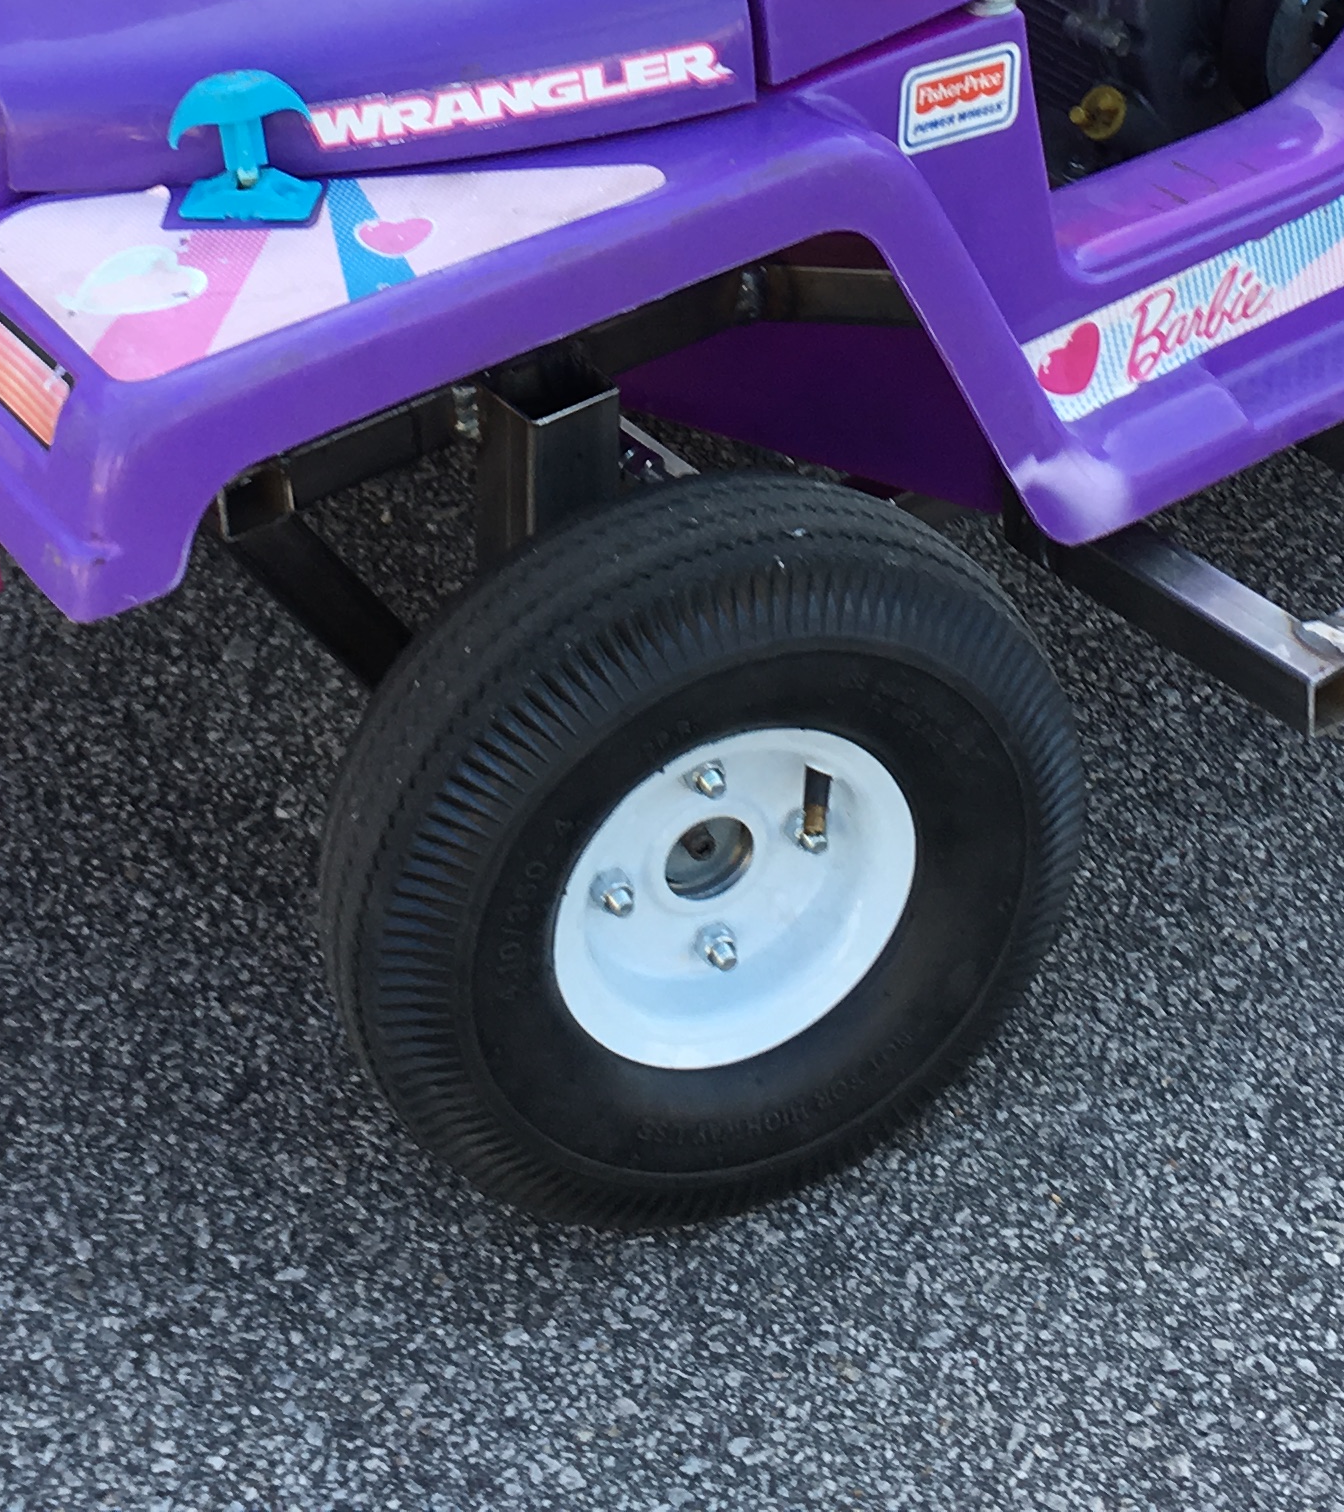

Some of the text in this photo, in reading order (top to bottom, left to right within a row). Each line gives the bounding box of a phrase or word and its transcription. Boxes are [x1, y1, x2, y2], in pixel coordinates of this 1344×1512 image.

[311, 43, 728, 147] WRANGLER
[917, 70, 1004, 107] Fisher-Price
[1127, 262, 1274, 383] Barbie
